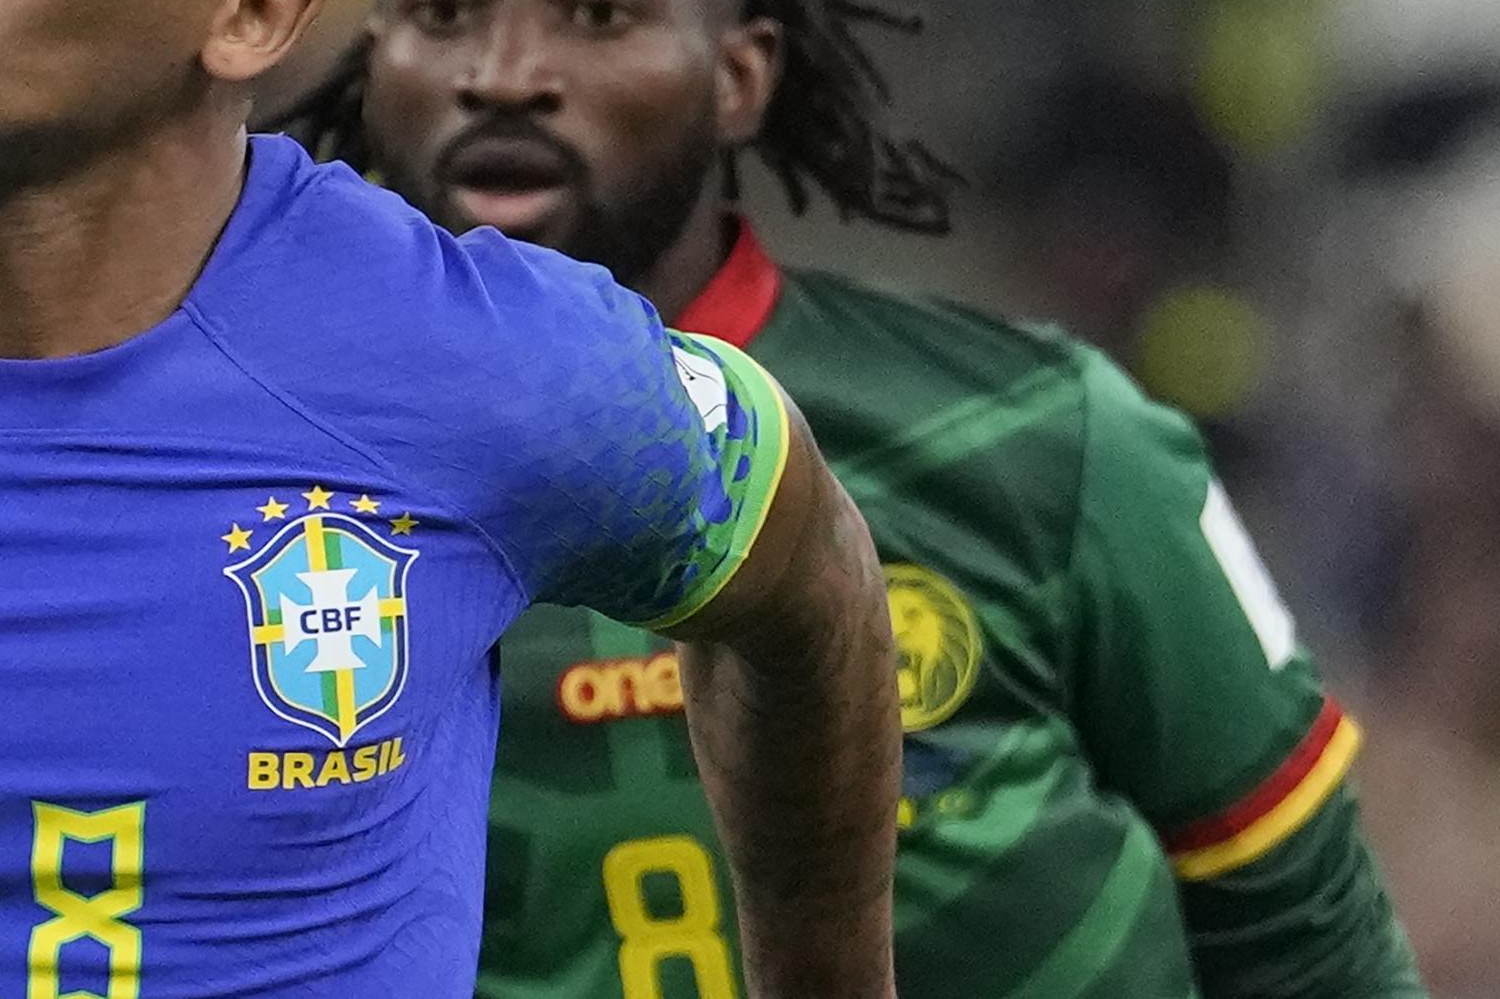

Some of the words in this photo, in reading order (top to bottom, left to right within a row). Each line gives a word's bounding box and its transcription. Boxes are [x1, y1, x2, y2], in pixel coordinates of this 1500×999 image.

[300, 606, 361, 634] CBF
[248, 737, 406, 790] BRASIL
[602, 834, 737, 999] 8
